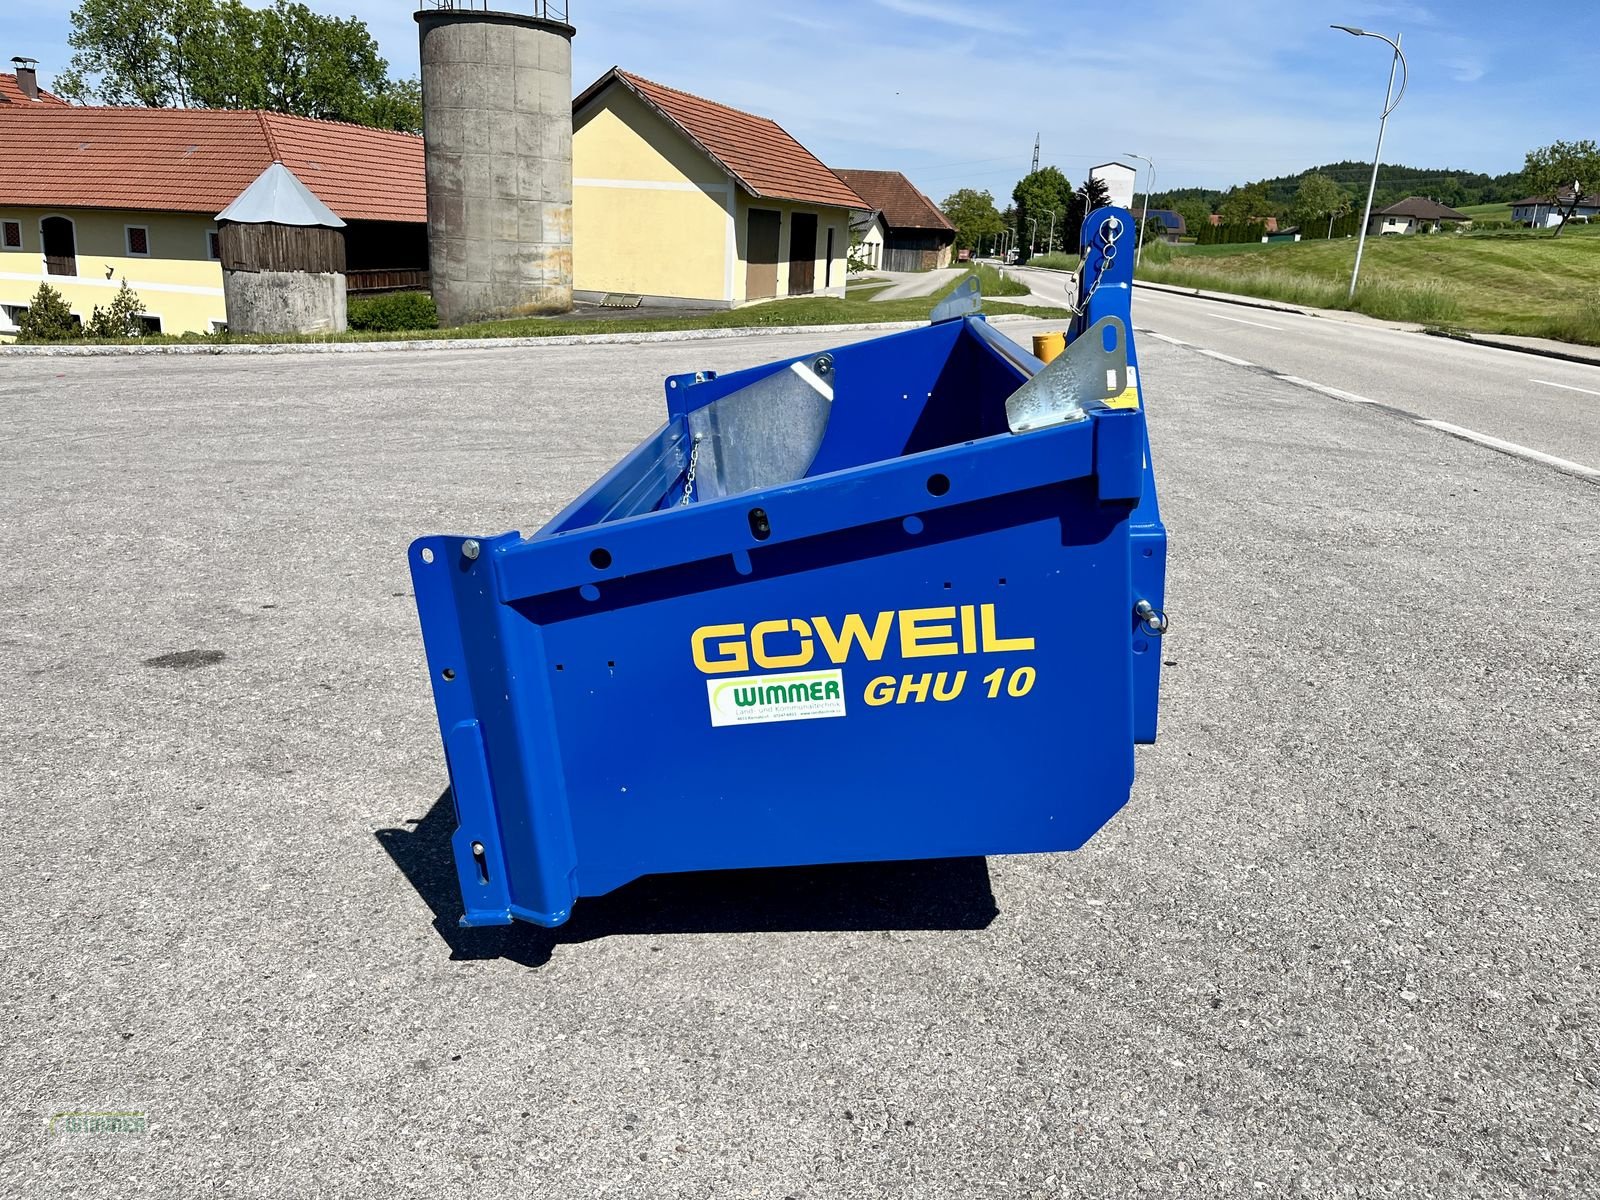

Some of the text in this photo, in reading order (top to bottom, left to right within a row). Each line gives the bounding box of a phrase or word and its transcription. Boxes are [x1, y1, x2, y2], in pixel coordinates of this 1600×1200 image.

[733, 680, 840, 707] WIMMER
[863, 666, 1036, 706] GHU 10
[759, 706, 773, 714] und
